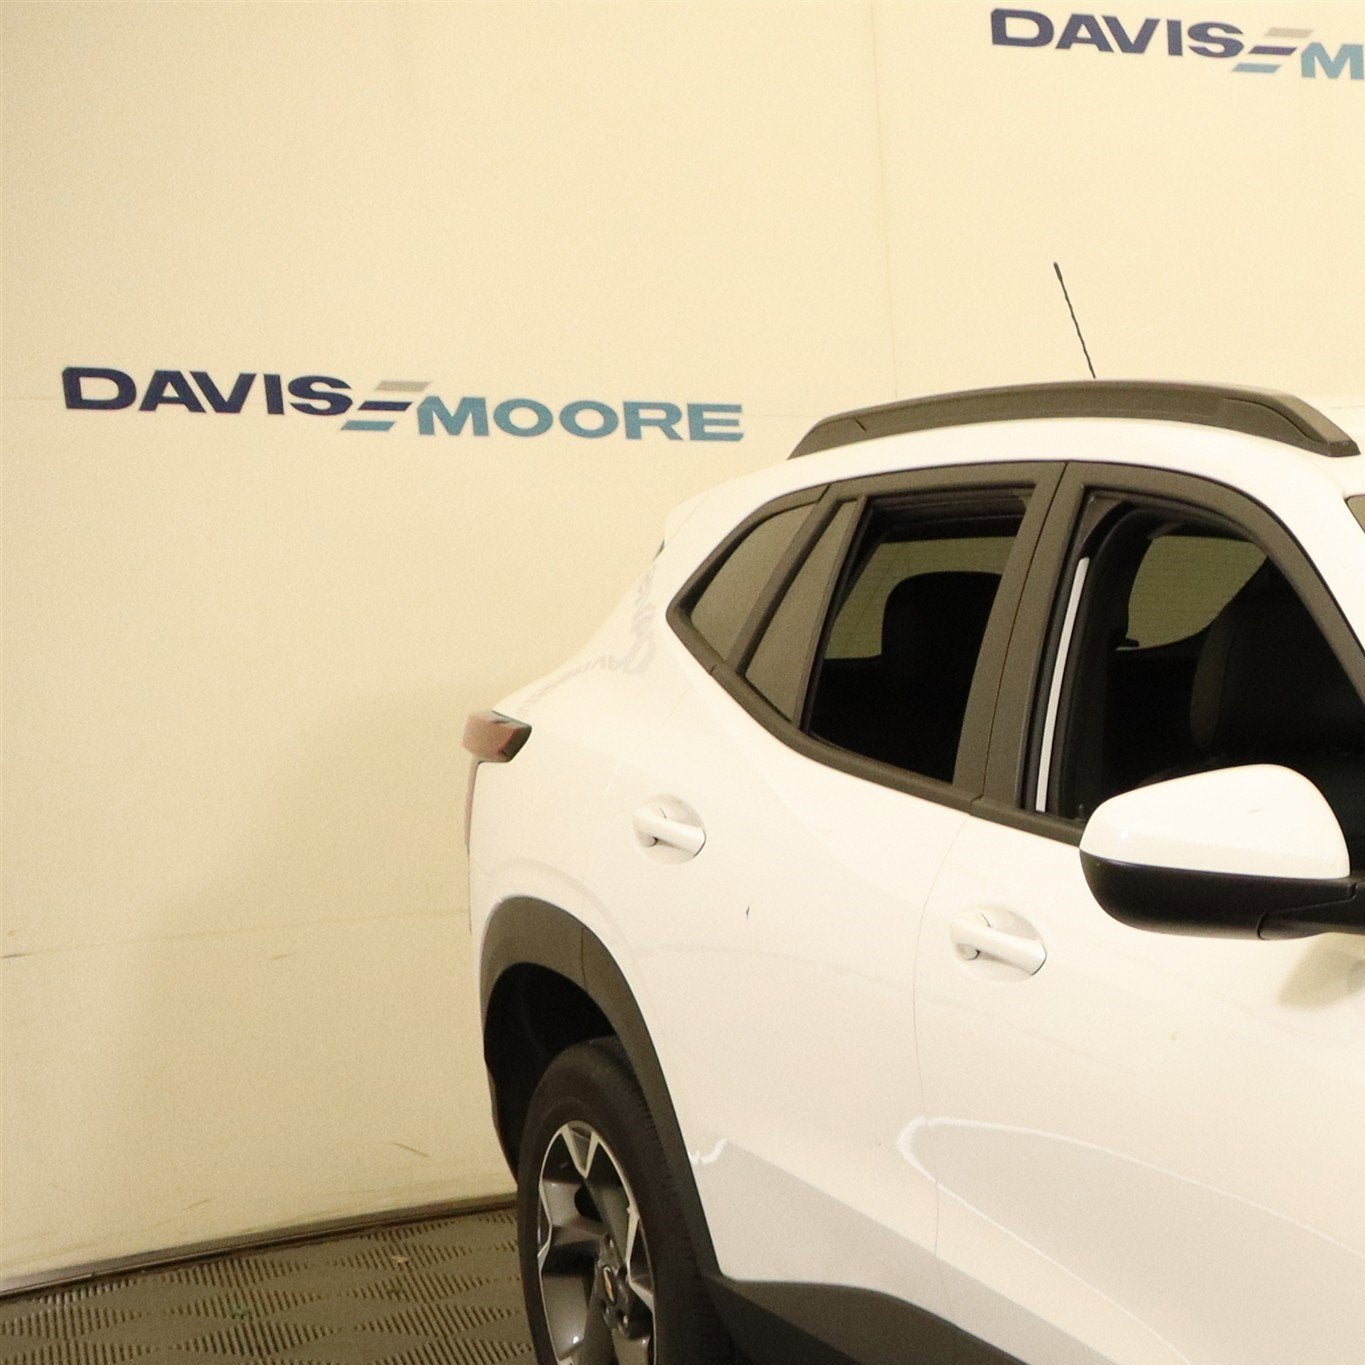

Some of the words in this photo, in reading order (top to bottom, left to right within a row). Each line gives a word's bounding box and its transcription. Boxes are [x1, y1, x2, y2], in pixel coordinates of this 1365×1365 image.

[990, 9, 1245, 58] DAVIS
[62, 366, 354, 417] DAVIS
[416, 396, 744, 442] MOORE
